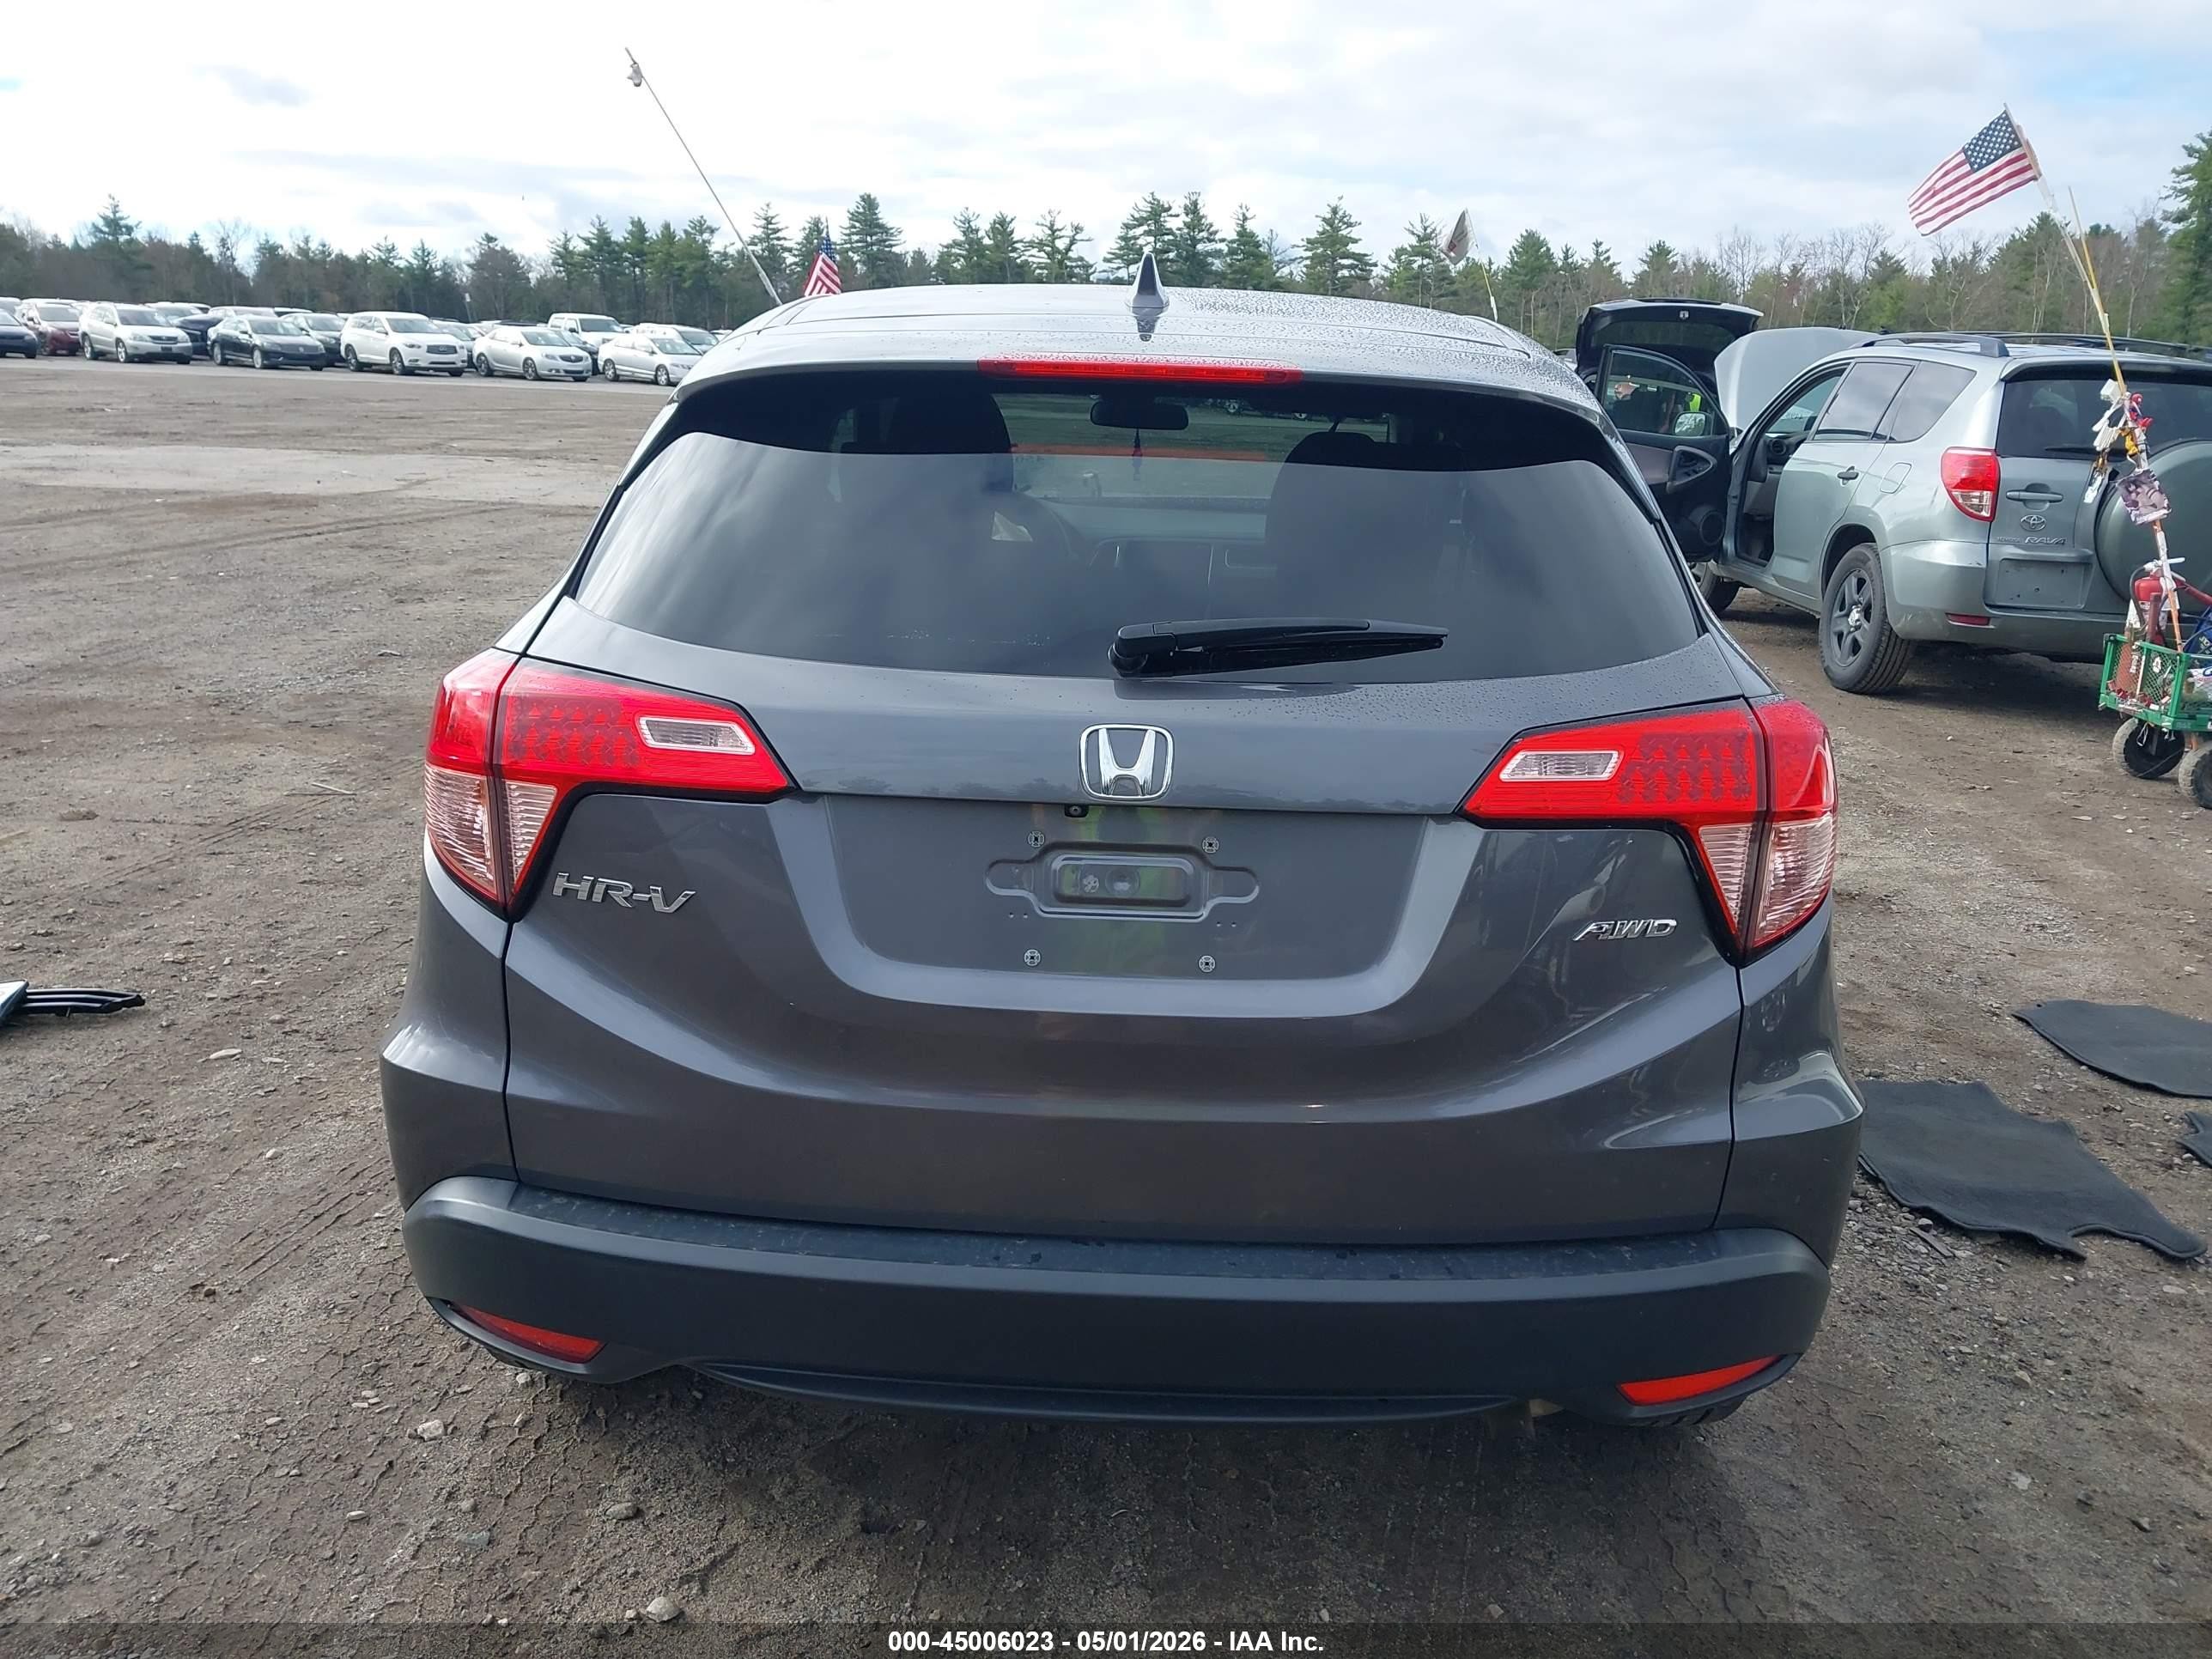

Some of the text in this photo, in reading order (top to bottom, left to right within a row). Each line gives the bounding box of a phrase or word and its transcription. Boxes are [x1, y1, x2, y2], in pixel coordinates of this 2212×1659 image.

[2024, 536, 2067, 545] RAV4
[552, 872, 696, 914] HR-V
[1572, 918, 1677, 941] AWD
